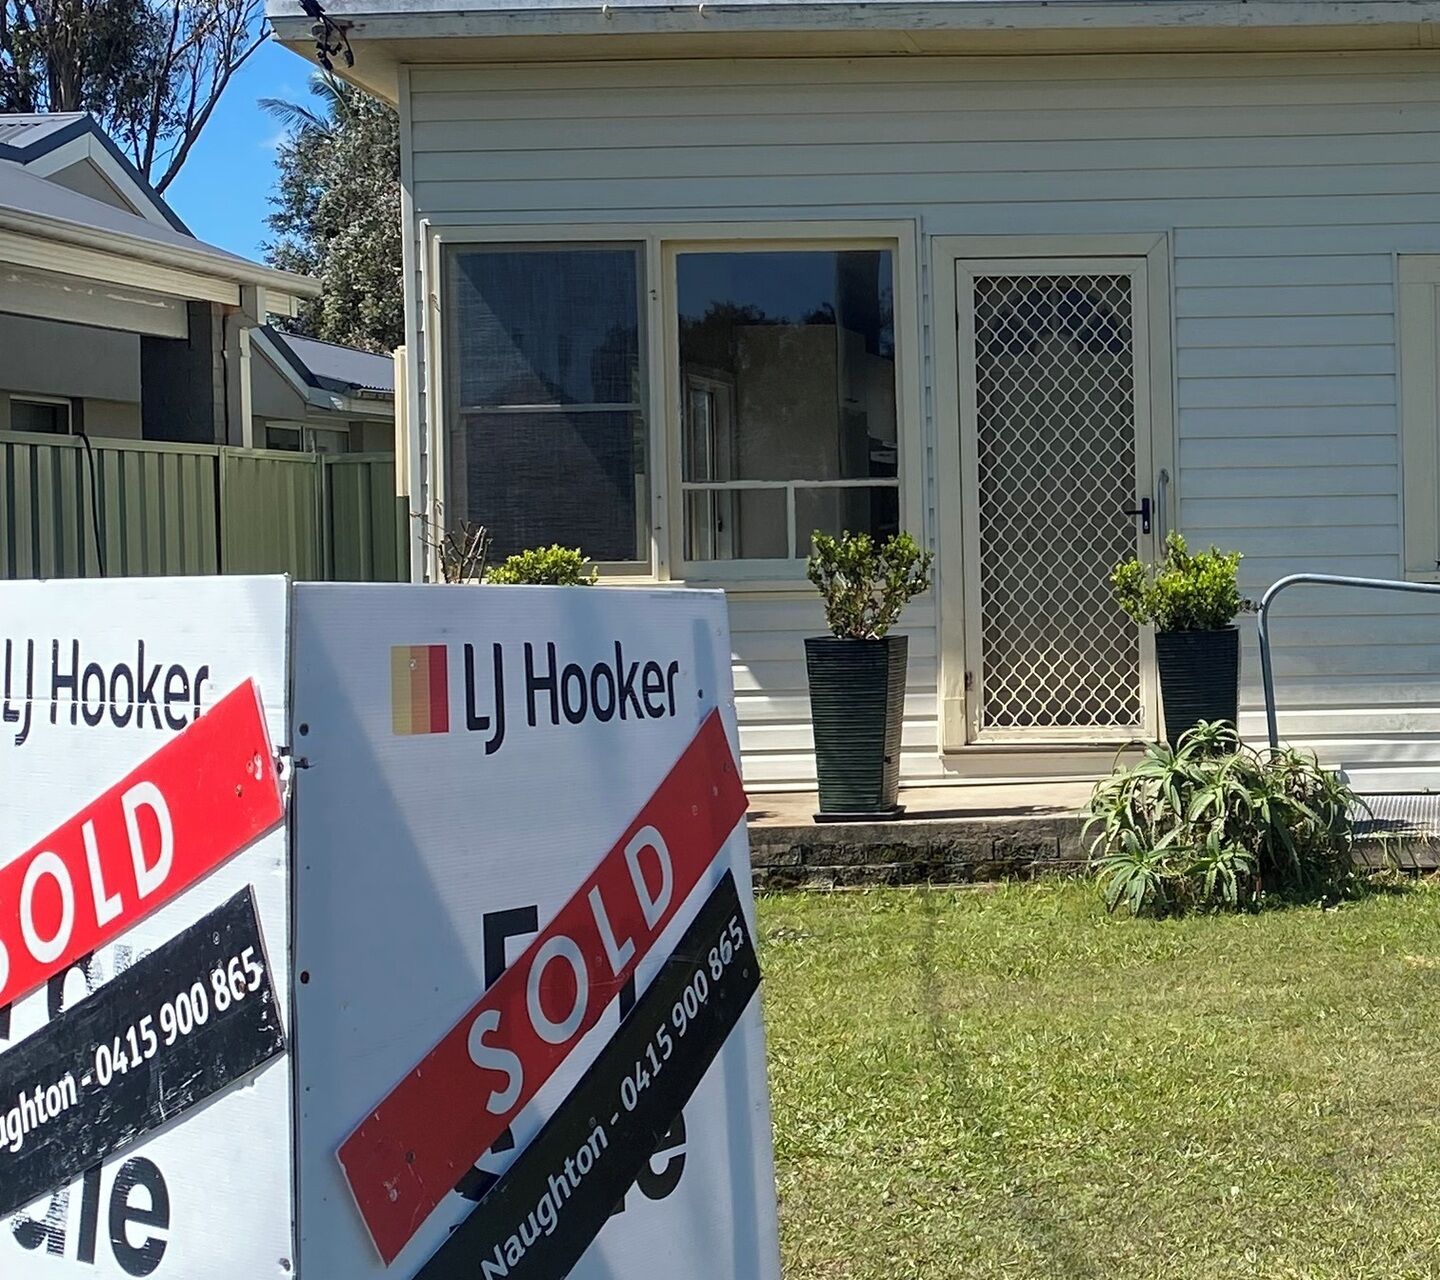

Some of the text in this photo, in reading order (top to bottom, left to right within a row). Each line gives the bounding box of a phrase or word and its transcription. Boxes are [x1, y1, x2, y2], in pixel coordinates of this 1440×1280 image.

[3, 638, 209, 746] LJ Hooker
[464, 640, 679, 756] LJ Hooker
[0, 781, 174, 996] OLD
[467, 824, 674, 1115] SOLD
[95, 1014, 158, 1086] 0415
[159, 981, 209, 1046] 900
[211, 946, 264, 1013] 865
[620, 1024, 673, 1113] 0415
[671, 969, 710, 1038] 900
[707, 915, 745, 982] 865
